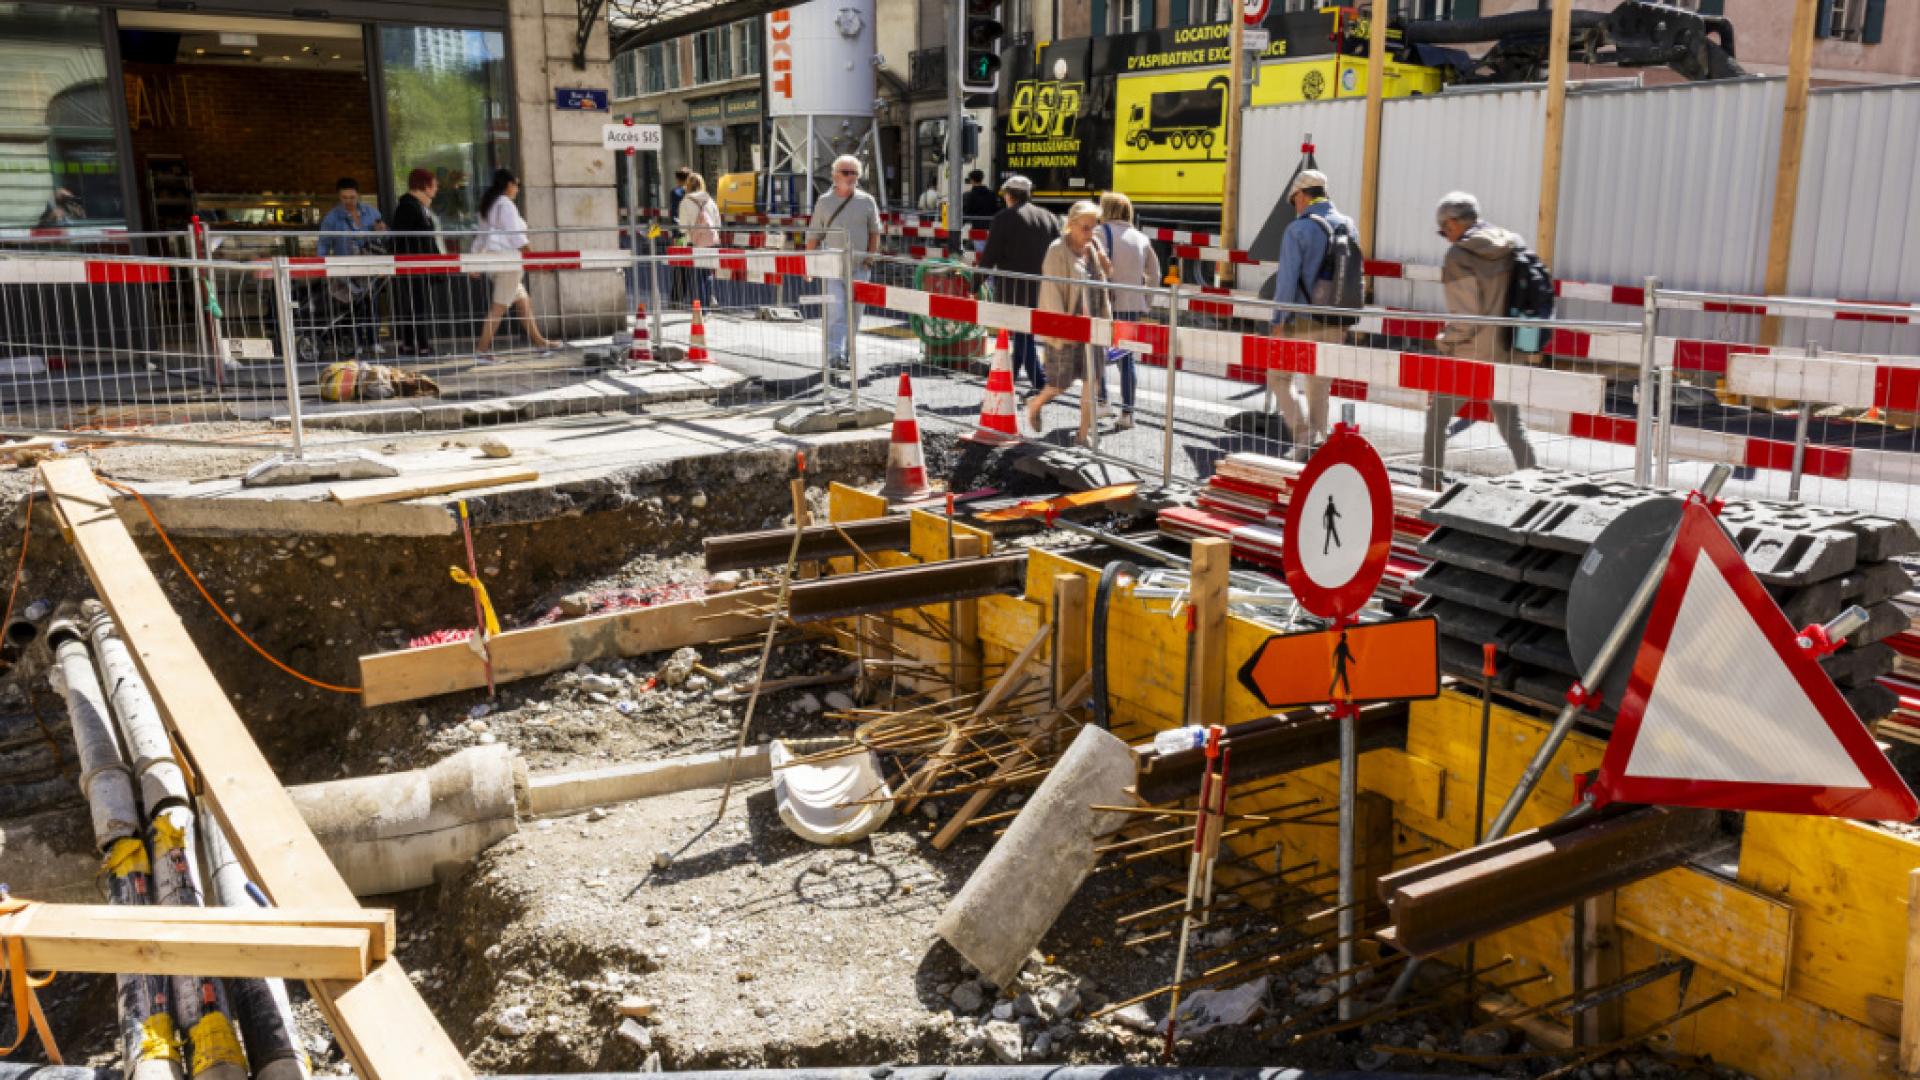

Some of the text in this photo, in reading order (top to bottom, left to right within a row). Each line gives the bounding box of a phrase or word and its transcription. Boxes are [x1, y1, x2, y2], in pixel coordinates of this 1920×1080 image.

[1174, 24, 1231, 43] LOCATION
[771, 9, 793, 98] IXIT
[1127, 48, 1206, 70] D'ASPIRATRICE
[607, 130, 660, 144] Accès SIS
